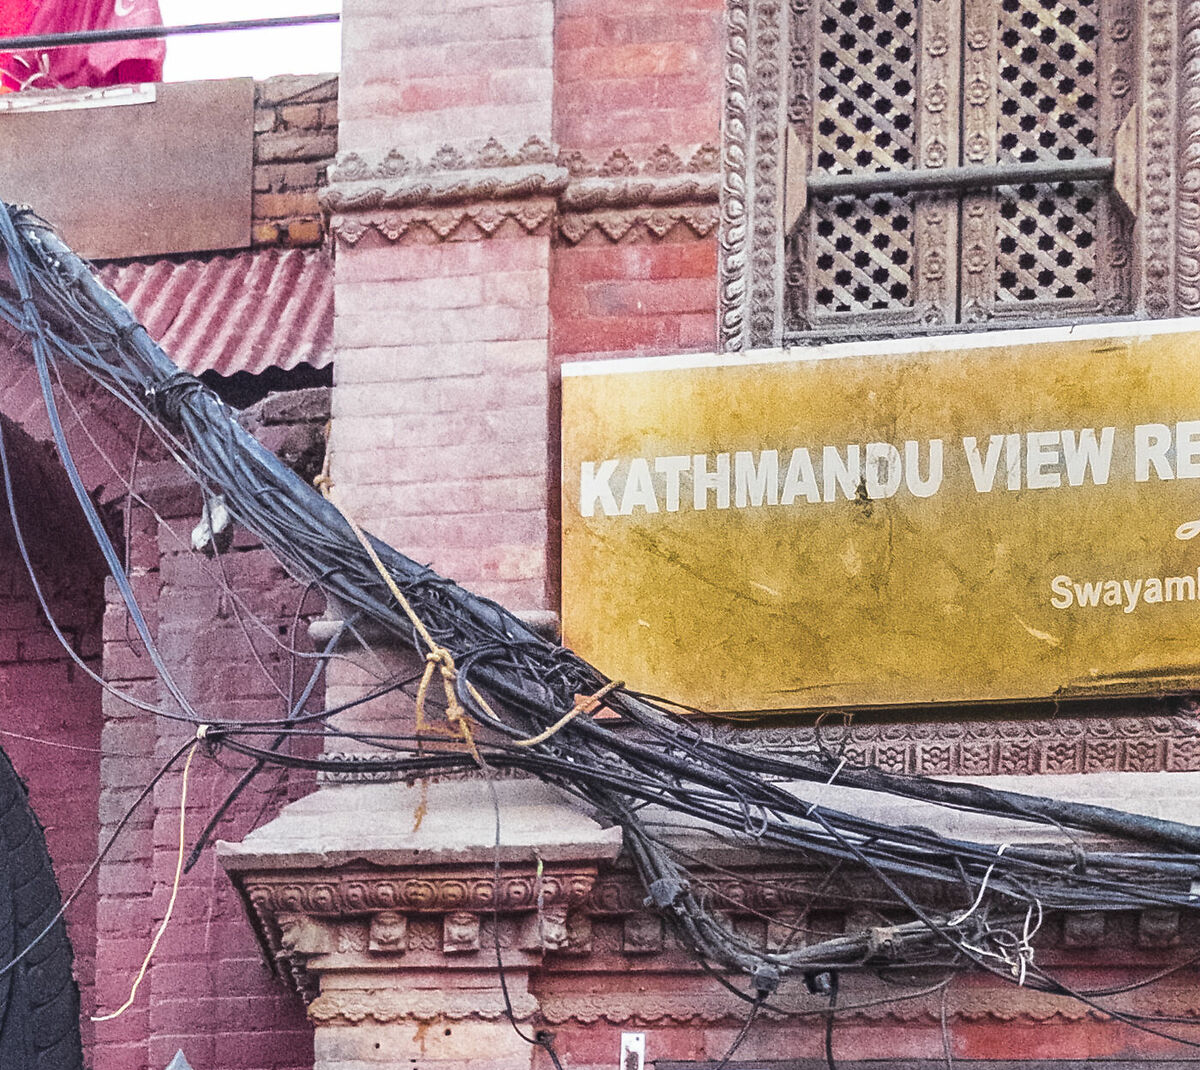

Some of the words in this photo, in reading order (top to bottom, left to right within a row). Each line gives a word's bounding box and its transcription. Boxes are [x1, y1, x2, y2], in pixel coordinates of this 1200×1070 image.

[580, 438, 944, 517] KATHMANDU
[963, 426, 1115, 493] VIEW
[1051, 567, 1200, 613] Swayam
